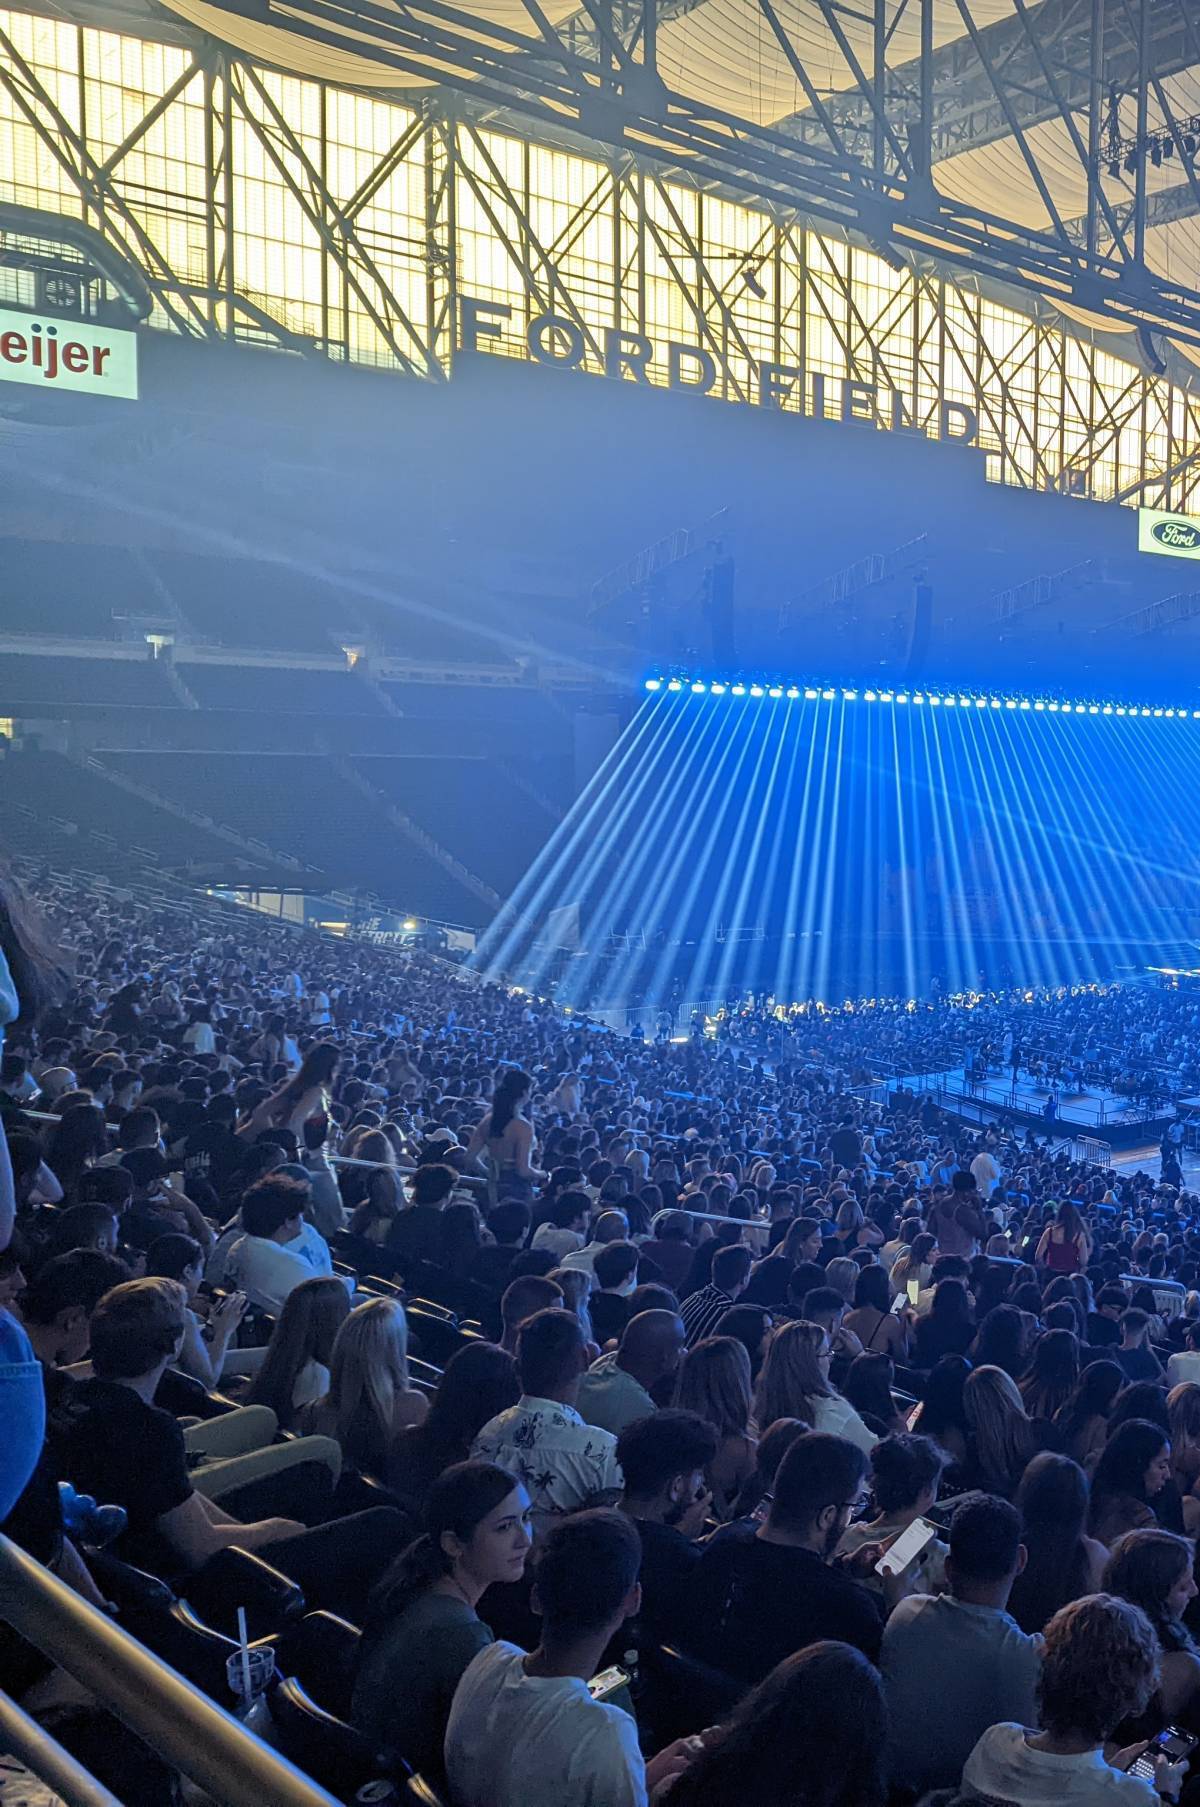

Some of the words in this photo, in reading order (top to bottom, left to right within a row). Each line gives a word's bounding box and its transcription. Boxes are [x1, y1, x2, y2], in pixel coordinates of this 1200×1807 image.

[0, 323, 110, 378] eijer
[458, 294, 717, 396] FORD
[759, 359, 978, 447] FIELD
[1161, 523, 1196, 547] Ford
